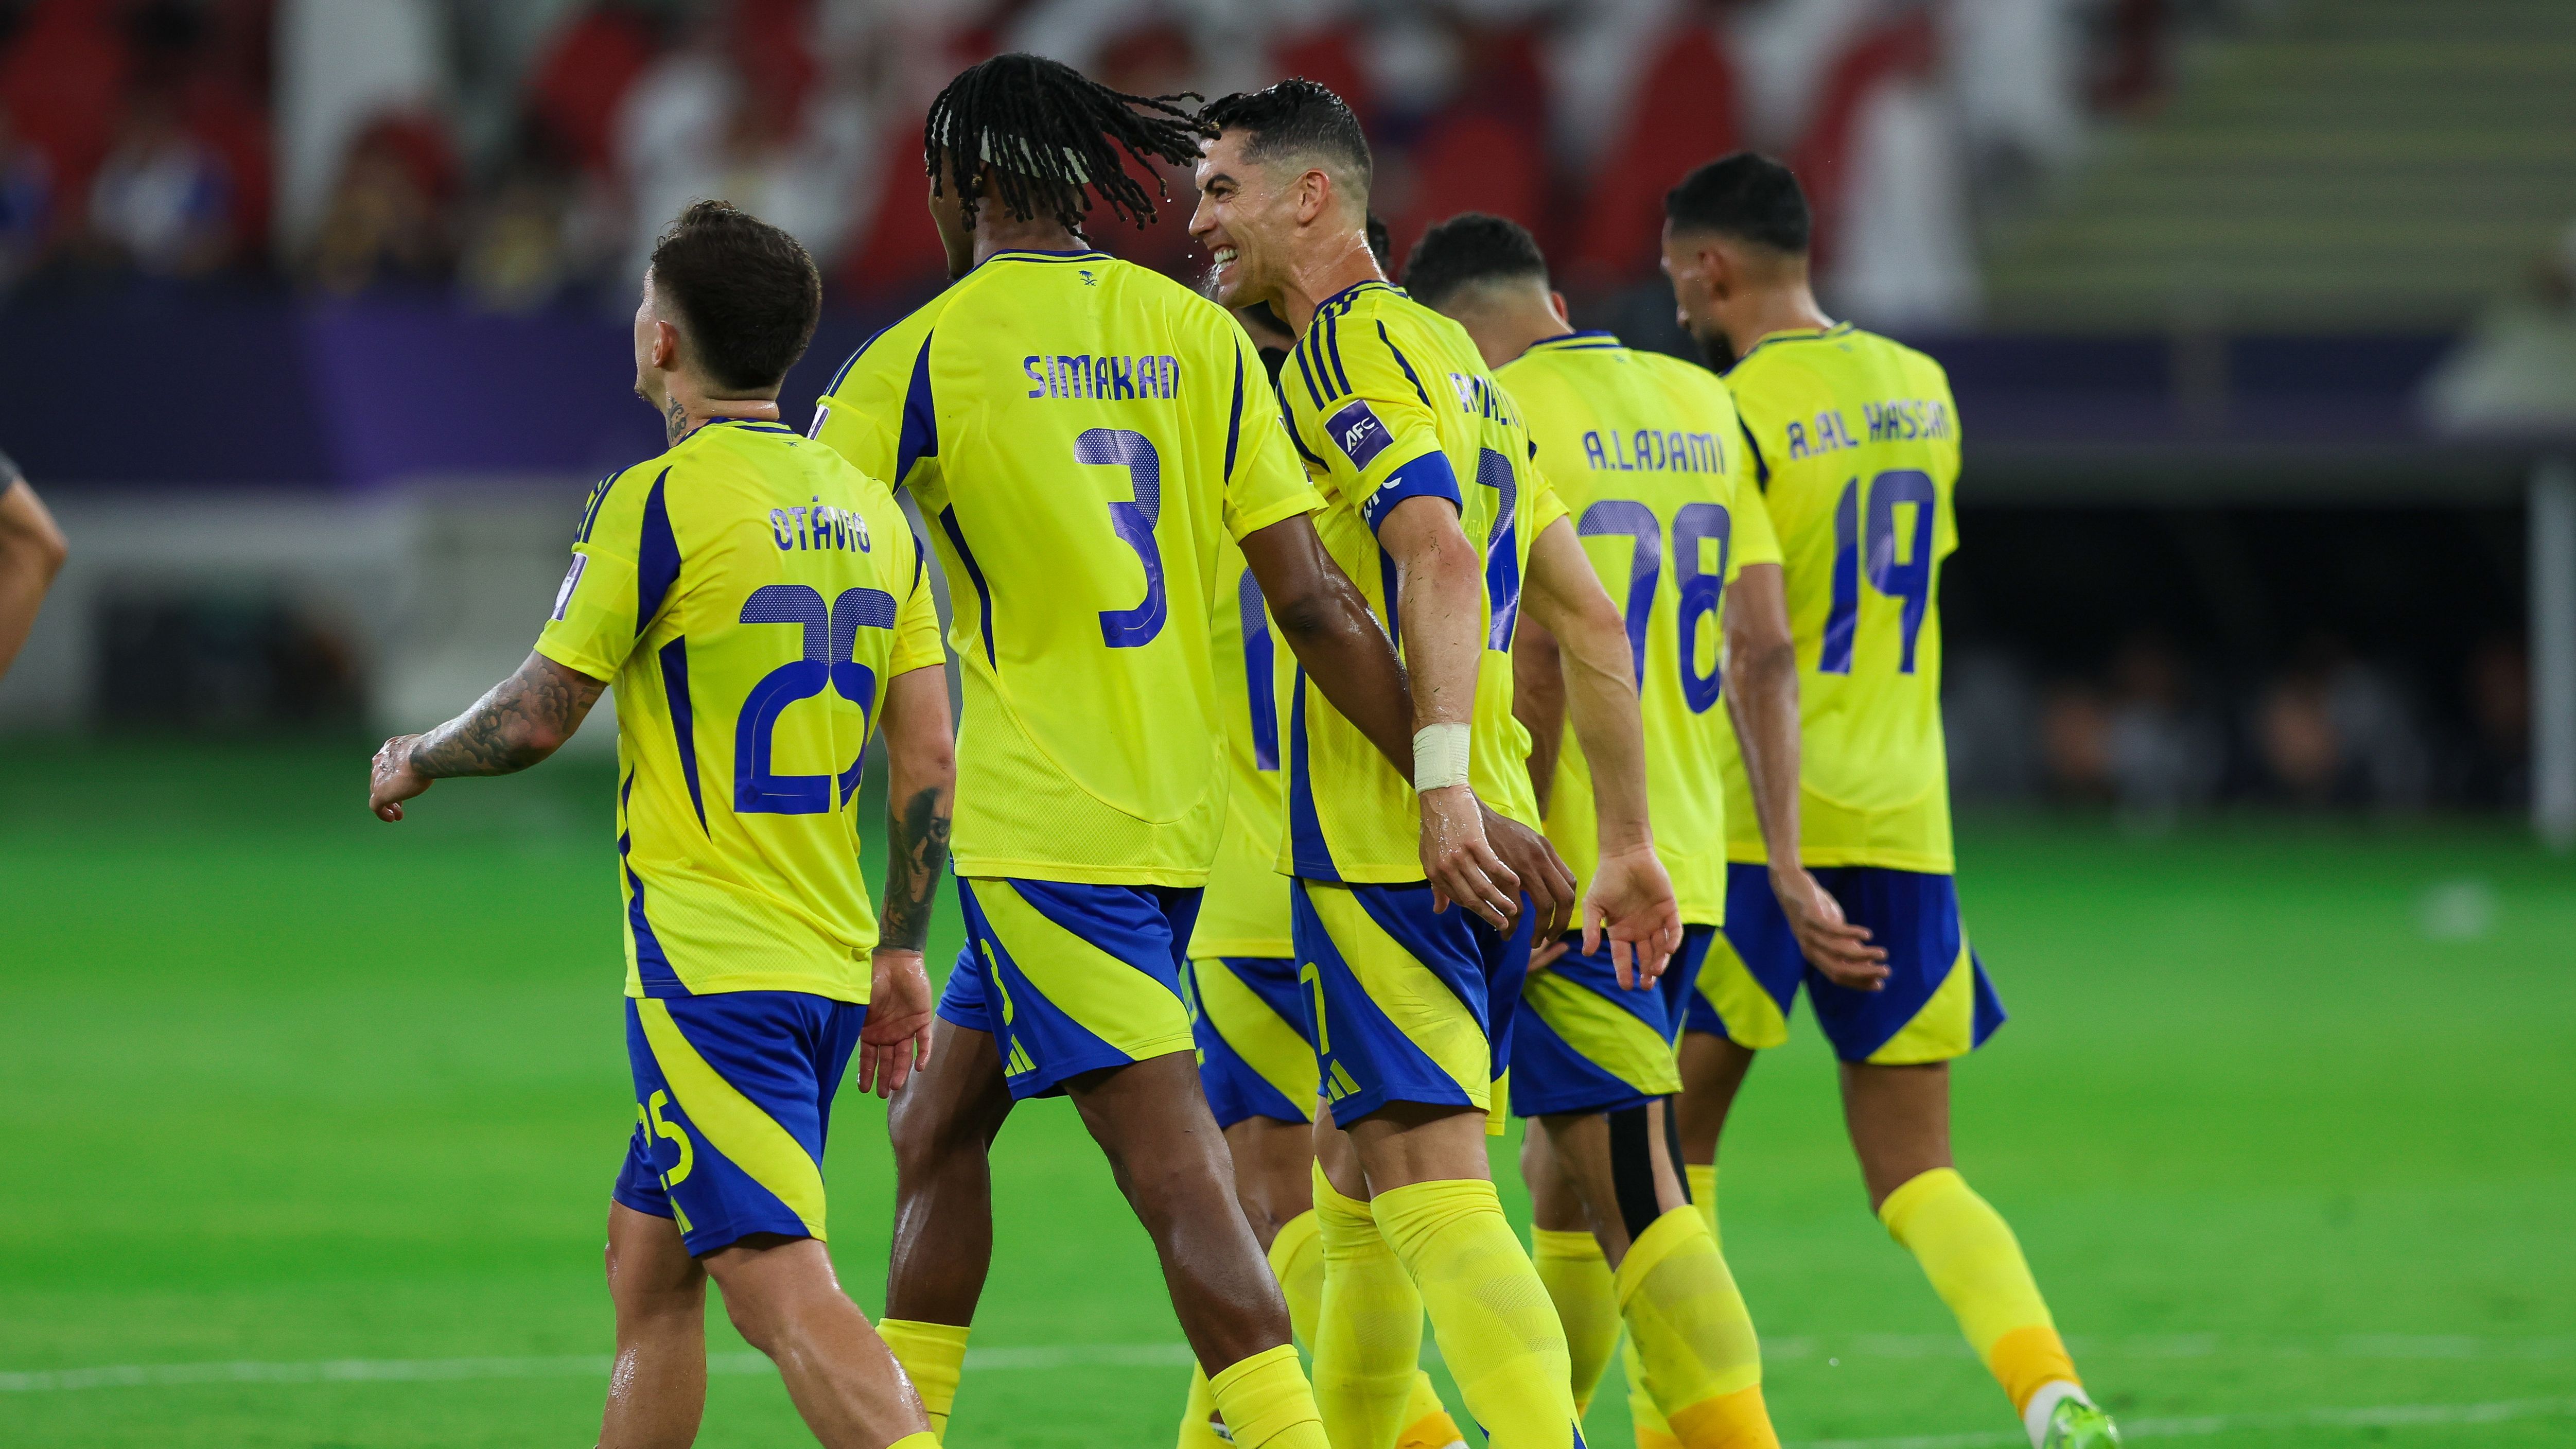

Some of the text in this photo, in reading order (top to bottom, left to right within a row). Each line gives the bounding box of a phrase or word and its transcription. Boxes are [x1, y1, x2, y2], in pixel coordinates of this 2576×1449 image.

[1023, 354, 1180, 401] SIMAKAN
[1345, 416, 1375, 453] AFC
[1582, 429, 1727, 475] A.LAJAMI
[1787, 410, 1858, 459] A.AL
[769, 495, 871, 554] OTÁVIO
[1074, 428, 1167, 648] 3
[1476, 447, 1519, 654] 7
[1818, 469, 1935, 674] 19
[1577, 499, 1730, 714] 78
[734, 584, 897, 813] 25
[1300, 962, 1330, 1056] 7
